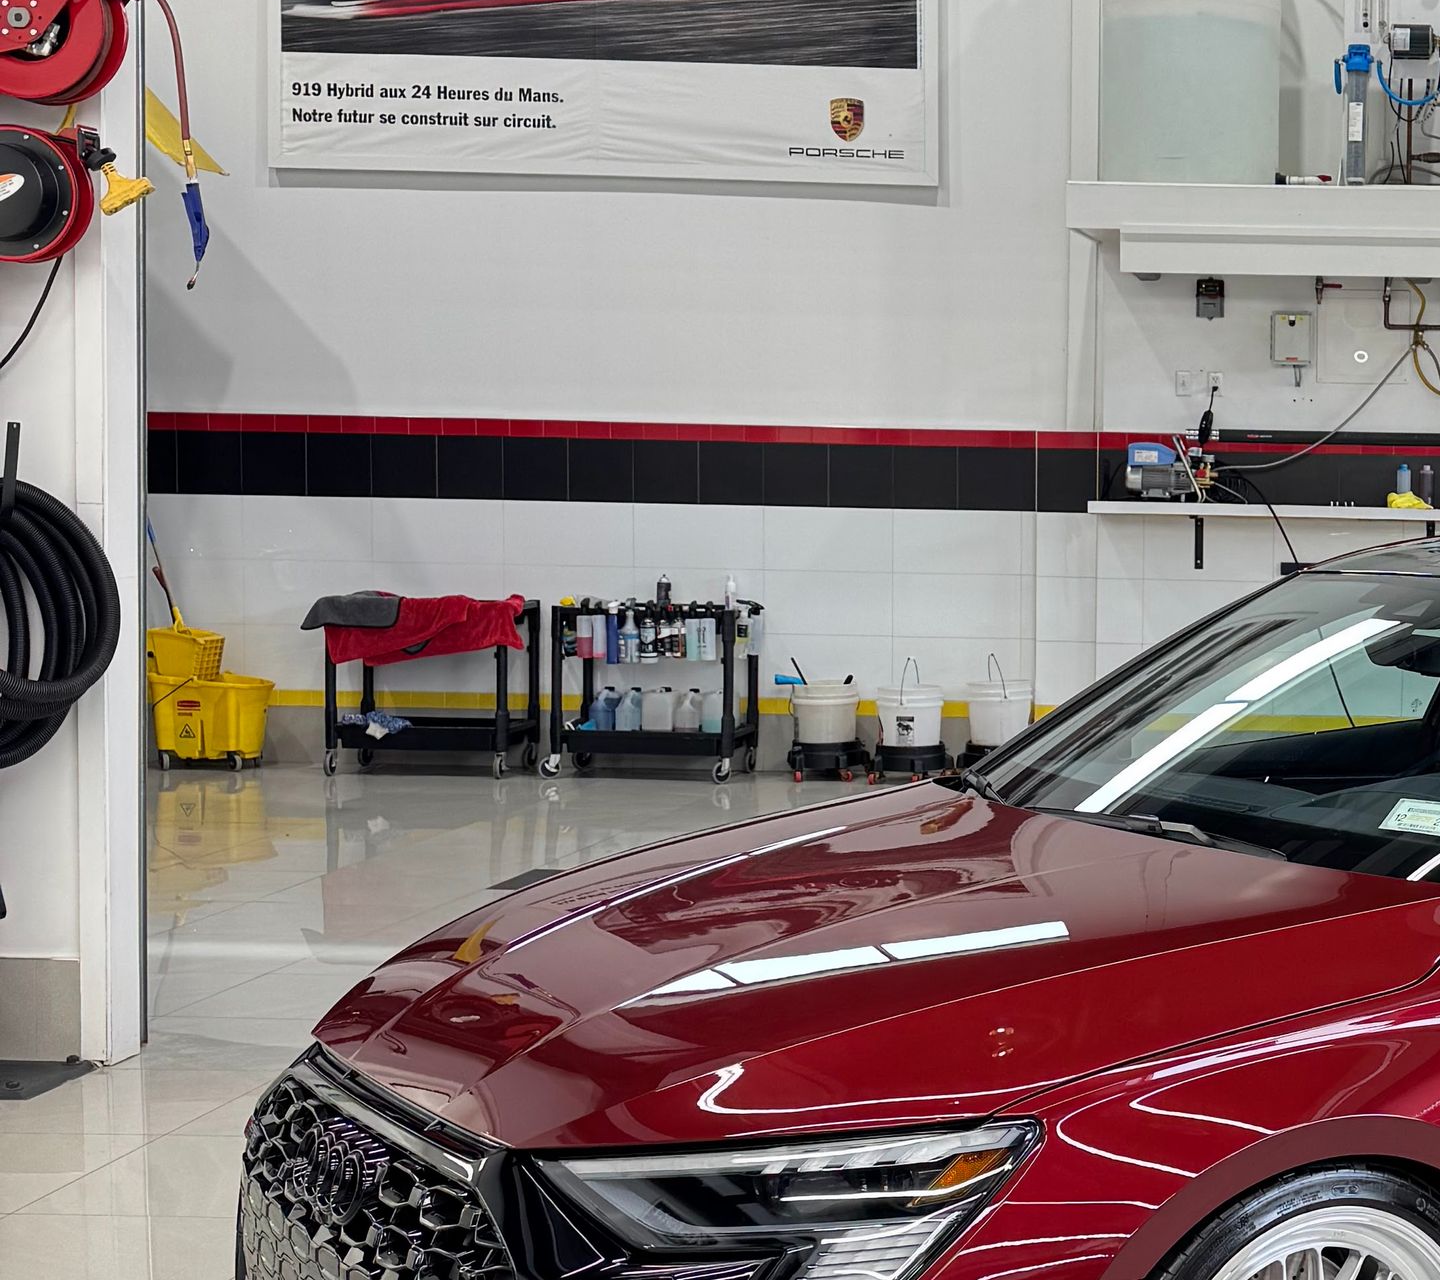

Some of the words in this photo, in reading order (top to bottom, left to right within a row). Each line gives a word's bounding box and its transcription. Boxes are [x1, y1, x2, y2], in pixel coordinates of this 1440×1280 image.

[292, 82, 321, 96] 919
[327, 83, 374, 99] Hybrid
[379, 87, 406, 98] aux
[411, 84, 431, 99] 24
[437, 85, 489, 101] Heures
[494, 87, 513, 101] du
[518, 88, 564, 103] Mans.
[292, 108, 332, 122] Notre
[337, 109, 374, 123] futur
[379, 112, 396, 124] se
[401, 111, 469, 126] construit
[474, 115, 498, 127] sur
[503, 113, 557, 129] circuit.
[788, 147, 905, 160] PORSCHE
